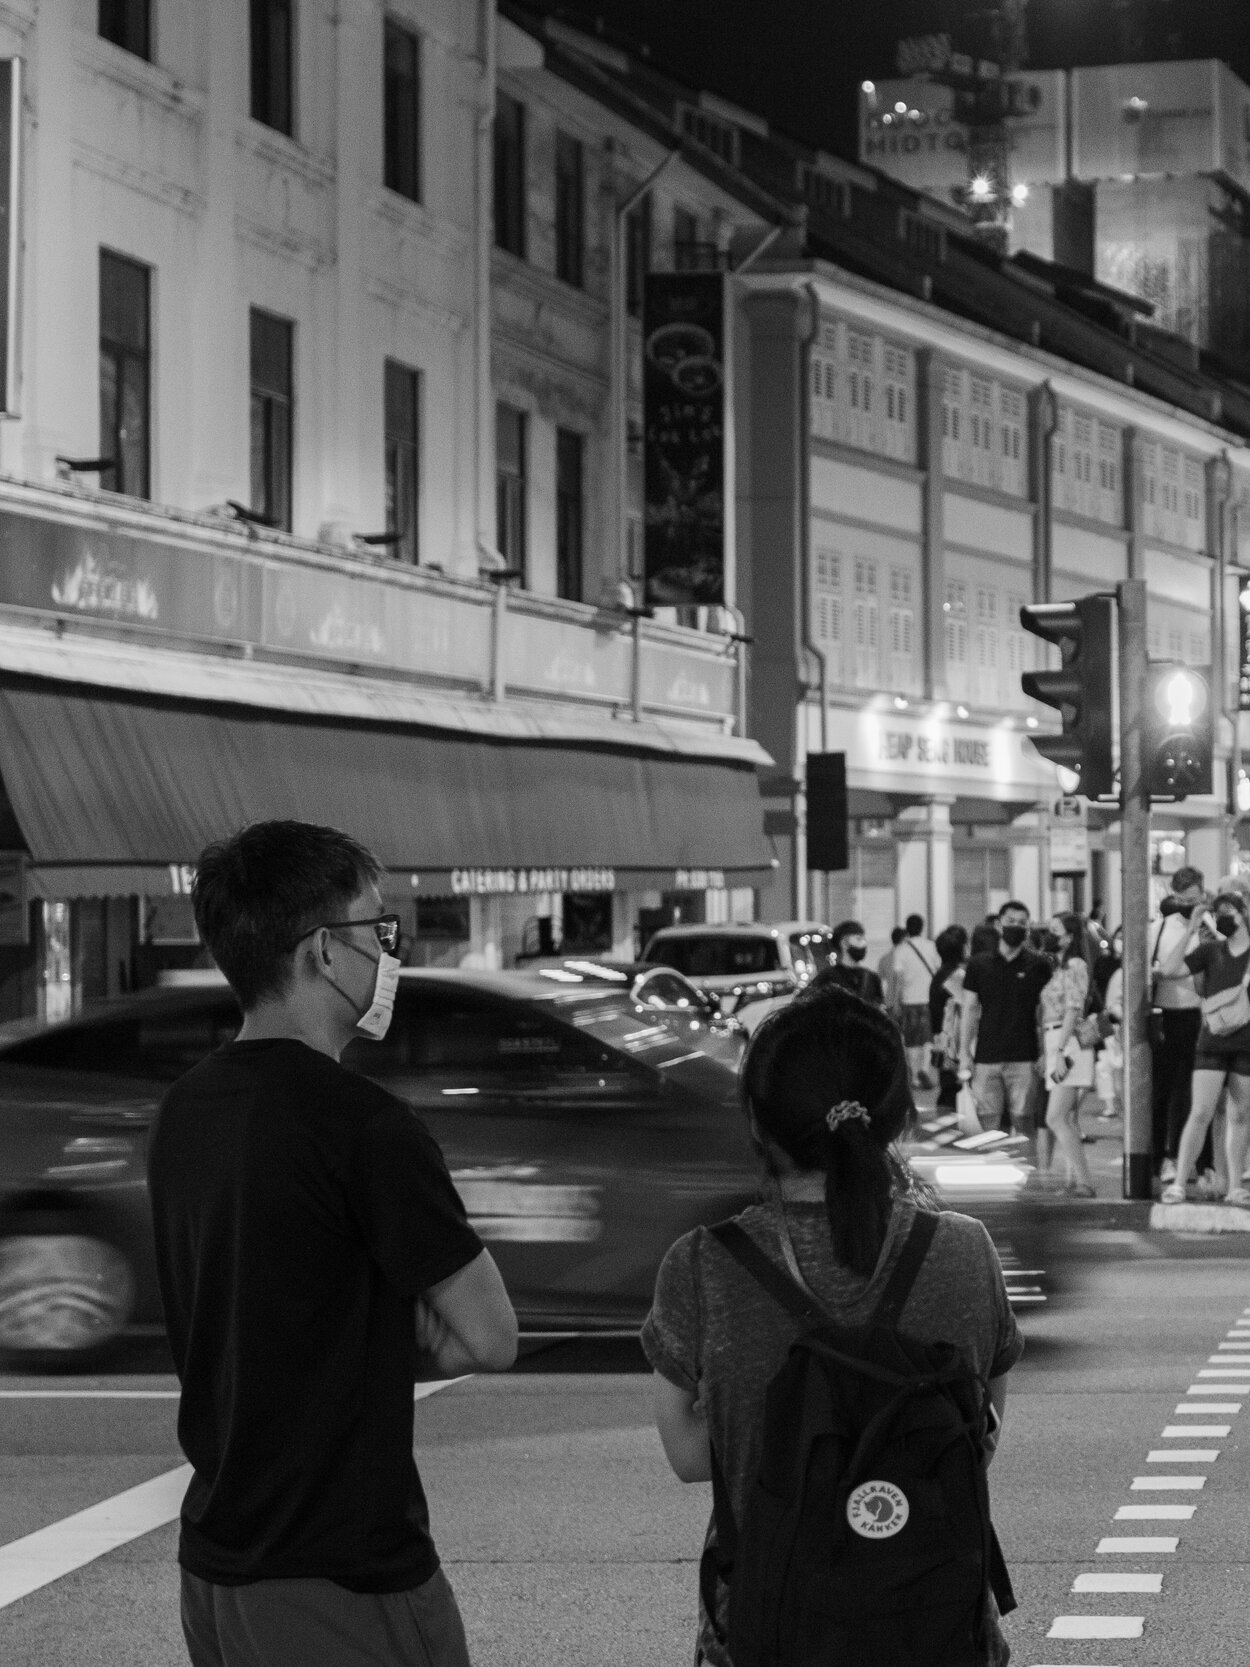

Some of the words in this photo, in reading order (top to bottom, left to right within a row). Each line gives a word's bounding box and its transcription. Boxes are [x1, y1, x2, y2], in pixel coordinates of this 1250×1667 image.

[451, 868, 516, 893] CATERING
[530, 868, 568, 891] PARTY
[569, 868, 616, 891] ORDERS
